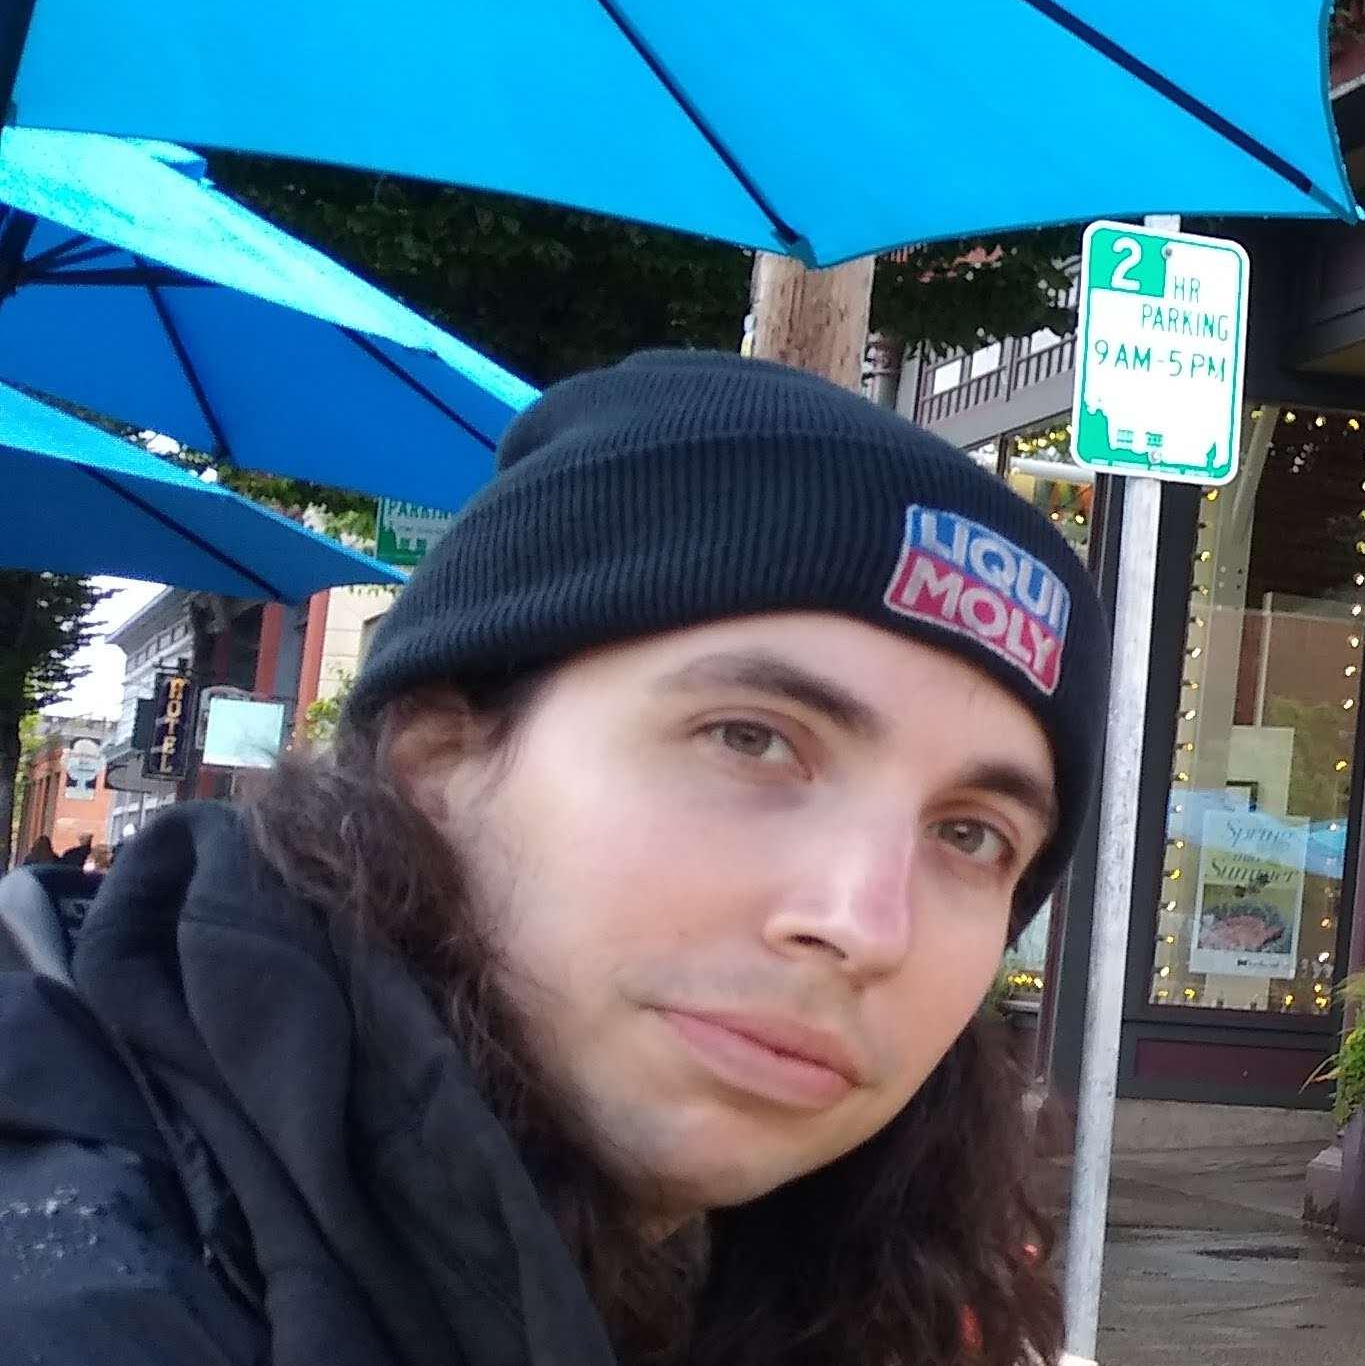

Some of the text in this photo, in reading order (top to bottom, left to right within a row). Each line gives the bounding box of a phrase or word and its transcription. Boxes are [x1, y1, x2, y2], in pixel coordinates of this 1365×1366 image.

[1110, 237, 1142, 291] 2
[1172, 275, 1200, 303] HR
[1141, 303, 1229, 341] PARKING
[919, 509, 1065, 628] LIQUI
[900, 555, 1057, 671] MOLY
